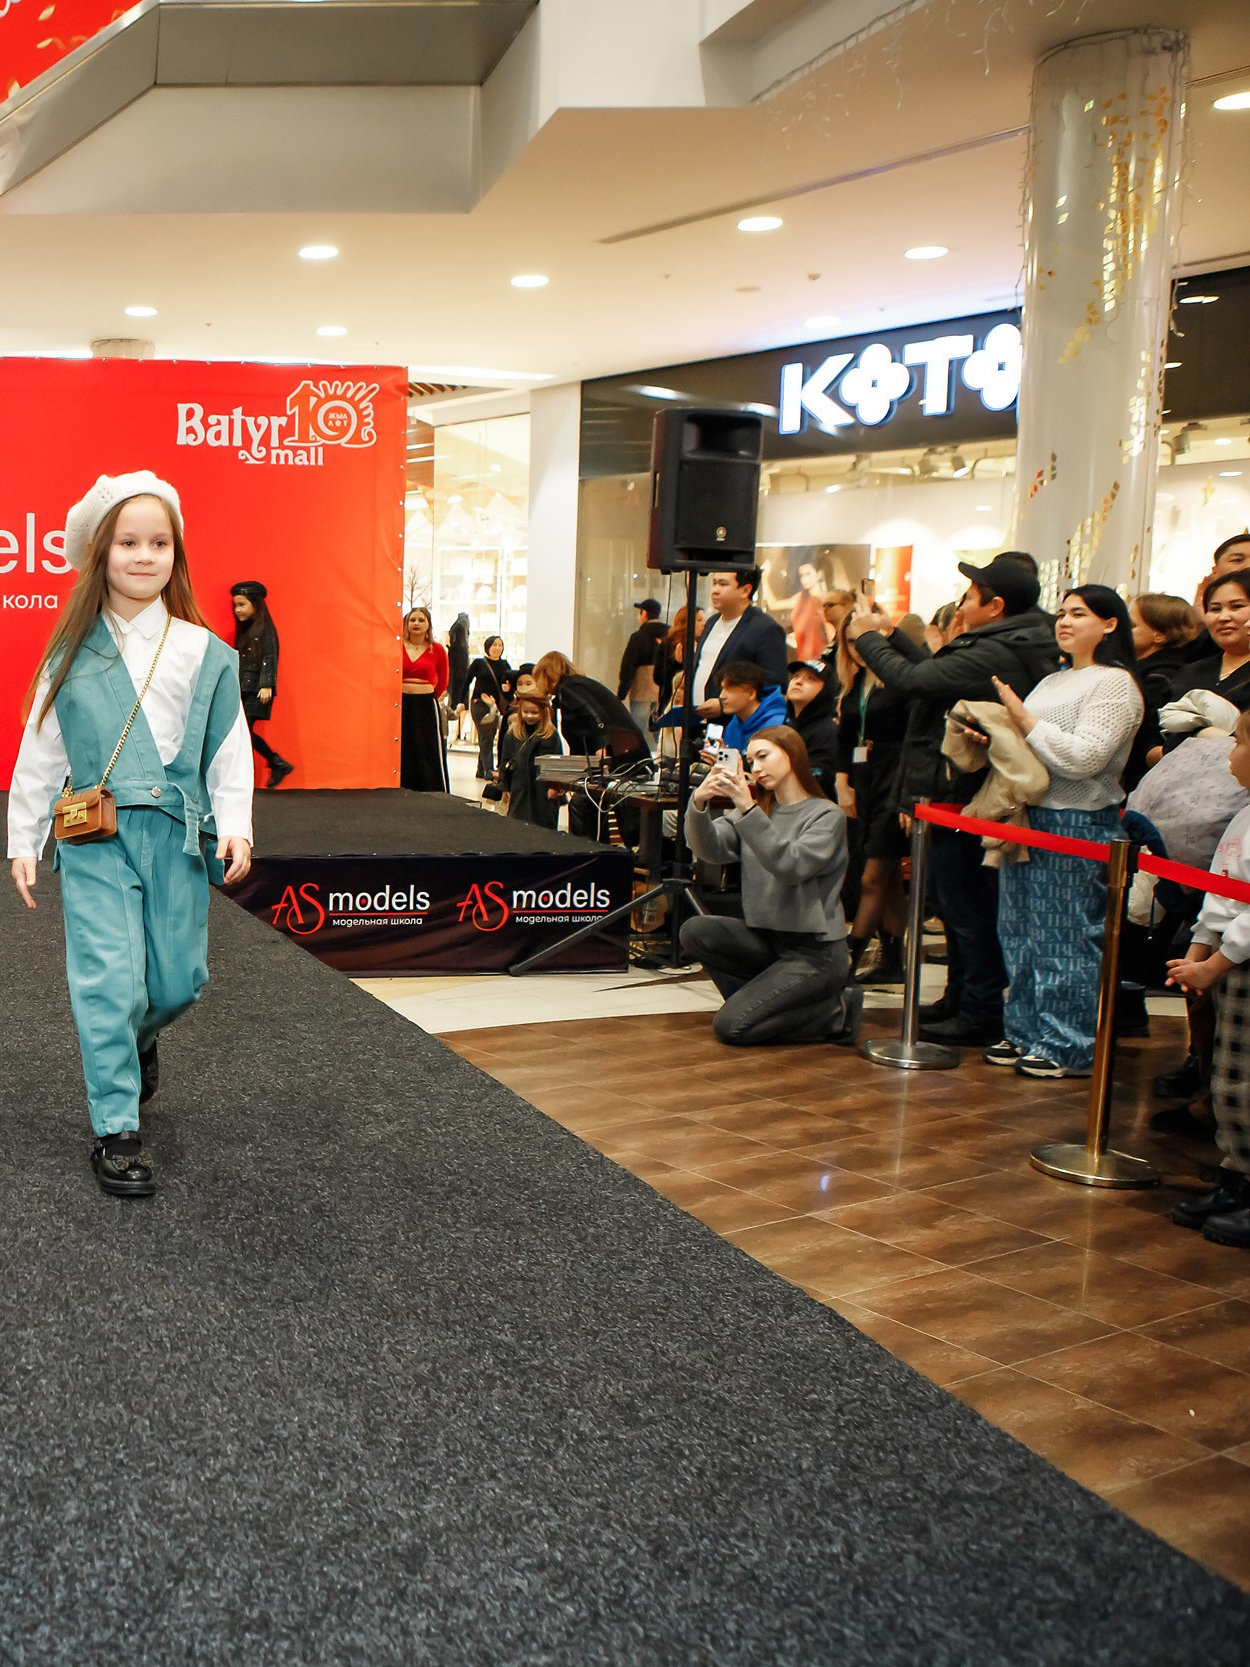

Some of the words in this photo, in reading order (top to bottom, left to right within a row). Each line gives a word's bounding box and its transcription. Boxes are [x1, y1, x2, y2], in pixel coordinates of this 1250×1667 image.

[779, 323, 1023, 435] KOTO
[177, 402, 288, 464] Batyr
[270, 447, 324, 466] mall
[271, 883, 326, 934] AS
[329, 885, 431, 911] models
[332, 918, 388, 928] модельная
[456, 881, 509, 932] AS
[512, 882, 611, 909] models
[515, 916, 570, 925] модельная
